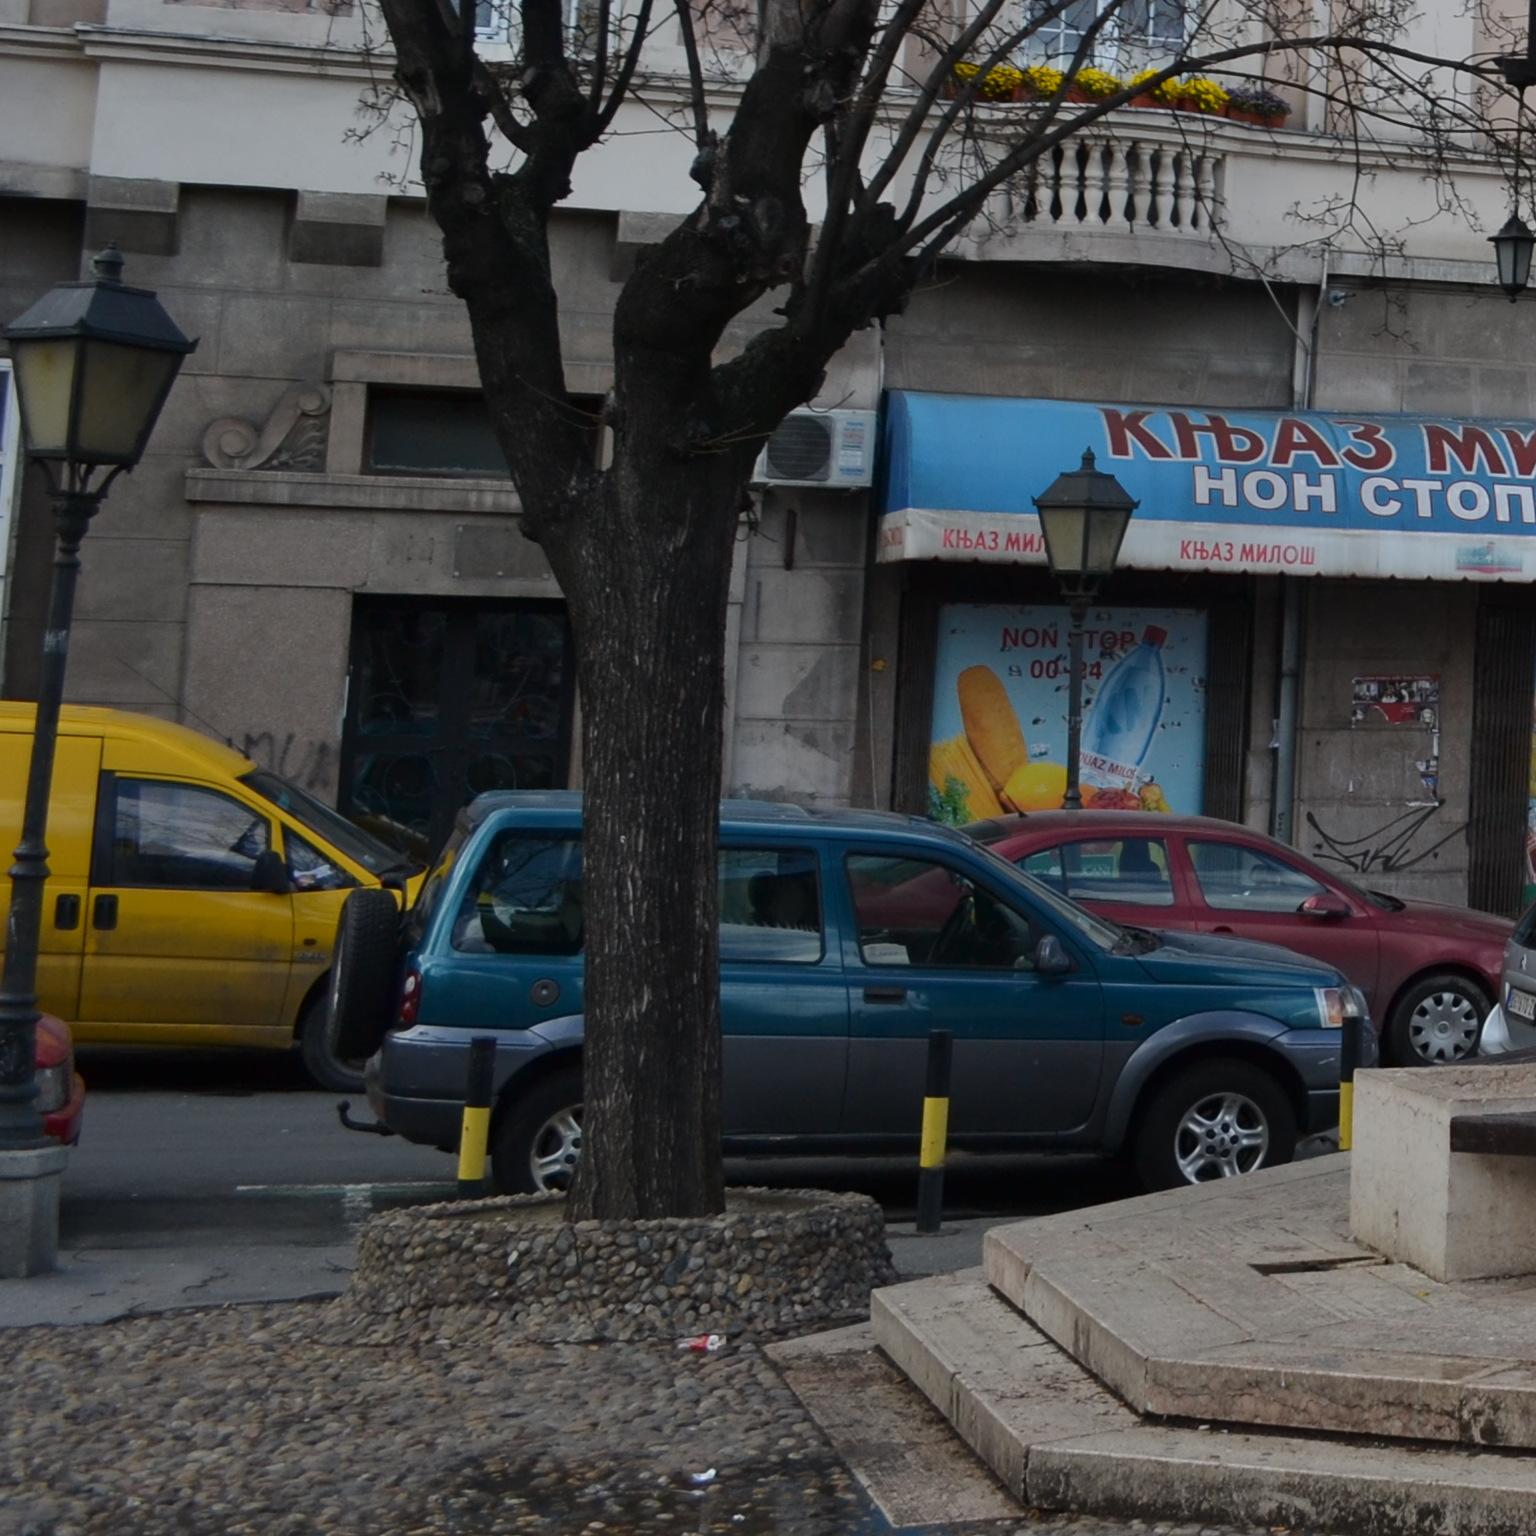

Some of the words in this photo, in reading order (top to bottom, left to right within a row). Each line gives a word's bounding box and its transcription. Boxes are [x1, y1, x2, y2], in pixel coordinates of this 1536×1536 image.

[1100, 406, 1397, 472] КЊАЗ
[1194, 465, 1338, 514] НОН
[942, 527, 999, 553] КЊАЗ
[1003, 532, 1046, 554] МИЛ
[1179, 539, 1235, 563] КЊАЗ
[1239, 542, 1316, 566] МИЛОШ
[1001, 626, 1058, 649] NON
